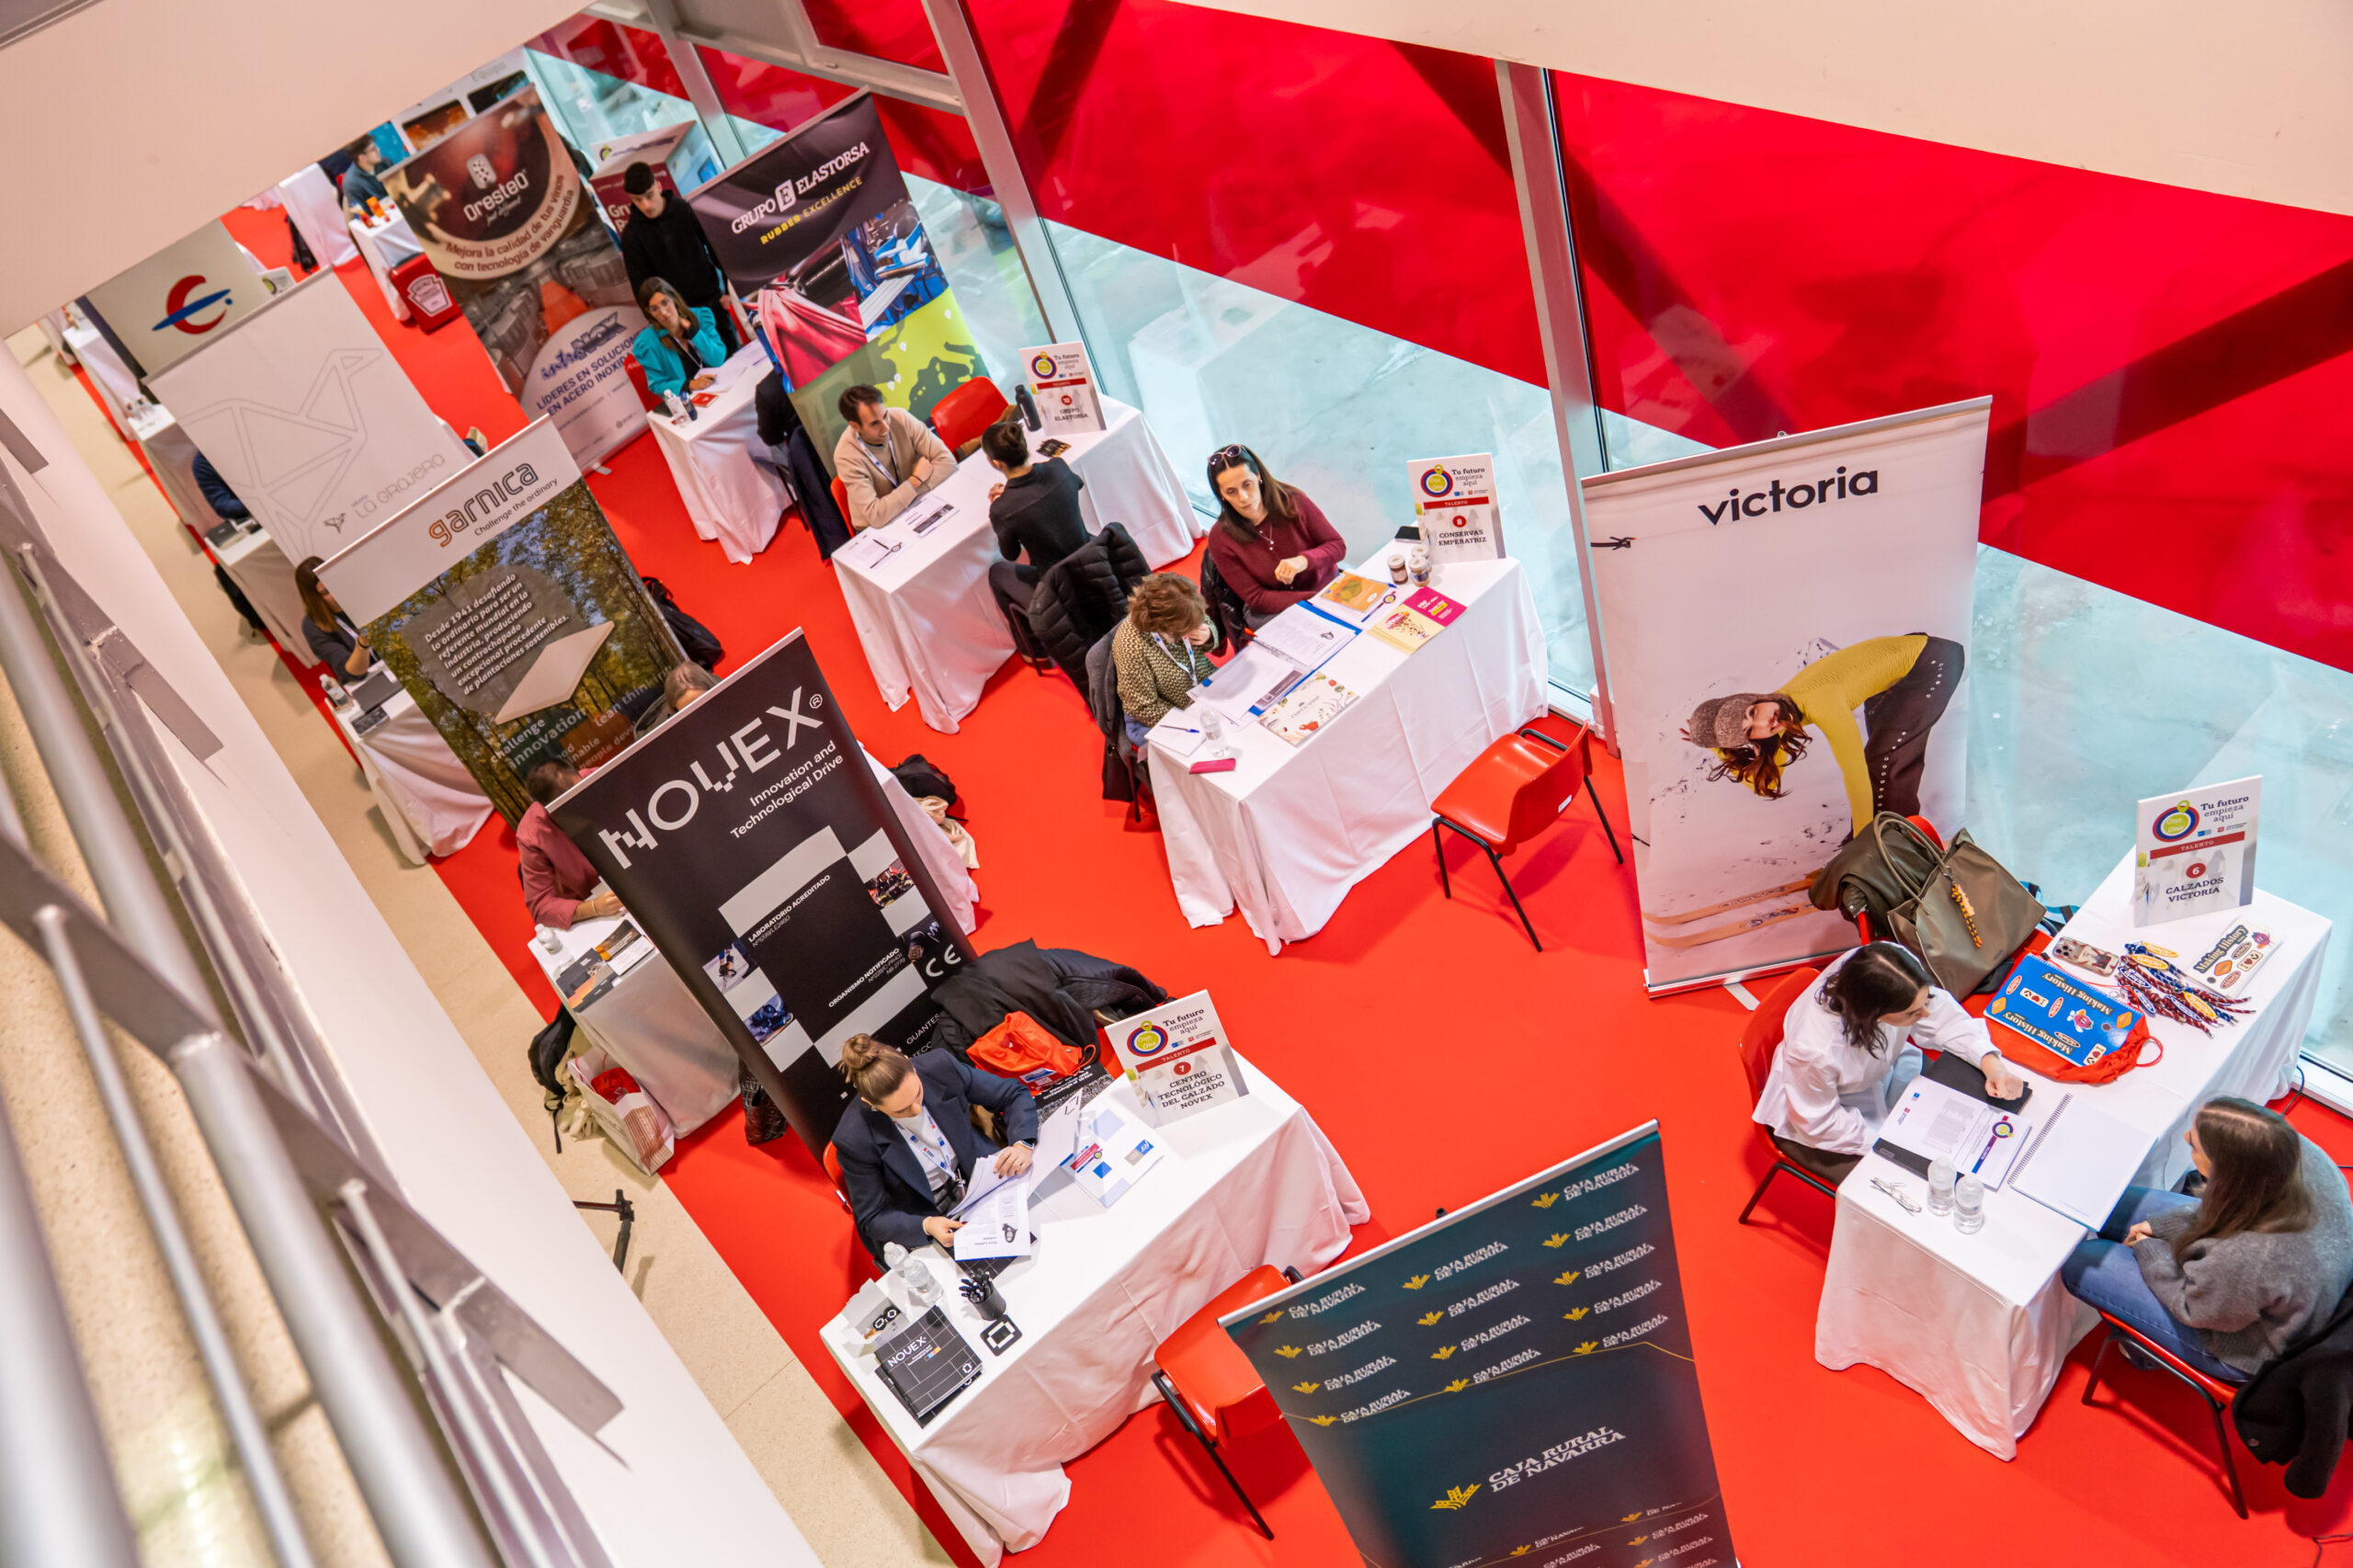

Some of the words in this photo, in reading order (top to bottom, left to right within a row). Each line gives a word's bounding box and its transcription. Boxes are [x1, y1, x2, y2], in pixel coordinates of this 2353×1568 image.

[731, 198, 777, 234] GRUPO
[795, 141, 870, 195] ELASTORSA
[445, 241, 483, 258] Mejora
[485, 247, 495, 257] la
[496, 231, 532, 256] calidad
[530, 221, 543, 234] de
[541, 204, 555, 222] tus
[551, 174, 564, 204] vinos
[759, 214, 801, 245] RUBBER
[801, 176, 863, 218] EXCELLENCE
[454, 260, 475, 271] con
[477, 249, 529, 271] tecnología
[529, 239, 542, 254] de
[540, 188, 574, 243] vanguardia
[536, 377, 576, 411] LÍDERES
[575, 368, 591, 382] EN
[546, 403, 563, 416] EN
[563, 379, 595, 406] ACERO
[428, 462, 540, 549] garnica
[474, 508, 513, 537] Challenge
[512, 498, 528, 513] the
[526, 477, 558, 504] ordinary
[1697, 466, 1878, 526] victoria
[1438, 537, 1487, 546] EMPERATRIZ
[1439, 529, 1483, 539] CONSERVAS
[425, 621, 450, 643] Desde
[450, 606, 473, 625] 1941
[472, 573, 517, 608] desafiando
[431, 641, 441, 653] lo
[441, 614, 480, 645] ordinario
[480, 602, 500, 619] para
[499, 591, 513, 604] ser
[511, 582, 523, 594] un
[438, 631, 475, 661] referente
[475, 606, 509, 634] mundial
[509, 597, 519, 608] en
[518, 590, 529, 602] la
[444, 639, 484, 669] industria,
[483, 601, 533, 642] produciendo
[450, 666, 461, 678] un
[461, 623, 522, 670] contrachapado
[457, 648, 504, 687] excepcional
[505, 616, 547, 654] procedente
[463, 684, 474, 696] de
[475, 648, 526, 689] plantaciones
[525, 615, 570, 650] sostenibles.
[595, 702, 622, 727] lean
[491, 718, 546, 764] challenge
[506, 710, 586, 770] innovation
[749, 760, 813, 807] Innovation
[813, 740, 836, 765] and
[730, 778, 813, 839] Technological
[813, 754, 844, 781] Drive
[2204, 804, 2245, 817] empieza
[2217, 796, 2249, 808] futuro
[2213, 813, 2234, 823] aquí
[2180, 840, 2214, 851] TALENTO
[2165, 877, 2224, 894] CALZADOS
[2168, 887, 2221, 903] VICTORIA
[748, 905, 792, 943] LABORATORIO
[792, 875, 831, 908] ACREDITADO
[2195, 949, 2225, 971] Making
[2218, 928, 2245, 950] History
[829, 976, 864, 1007] ORGANISMO
[864, 948, 899, 978] NOTIFICADO
[2042, 972, 2077, 996] History
[1163, 1018, 1176, 1028] Tu
[1176, 1008, 1204, 1022] futuro
[2078, 991, 2114, 1016] Making
[1169, 1017, 1203, 1031] empieza
[1180, 1024, 1198, 1035] aquí
[2003, 1011, 2037, 1035] History
[1162, 1049, 1191, 1062] TALENTO
[2038, 1029, 2075, 1055] Making
[1158, 1074, 1222, 1100] TECNOLÓGICO
[1162, 1097, 1180, 1108] DEL
[1181, 1081, 1225, 1100] CALZADO
[1169, 1071, 1207, 1088] CENTRO
[1180, 1094, 1213, 1108] NOVEX
[1563, 1178, 1592, 1194] CAJA
[1594, 1163, 1632, 1182] RURAL
[1565, 1189, 1583, 1201] DE
[1585, 1166, 1640, 1193] NAVARRA
[1574, 1221, 1603, 1235] CAJA
[1605, 1204, 1641, 1222] RURAL
[1576, 1230, 1592, 1241] DE
[1595, 1206, 1648, 1233] NAVARRA
[1585, 1259, 1611, 1273] CAJA
[1613, 1243, 1649, 1262] RURAL
[1586, 1268, 1602, 1278] DE
[1604, 1244, 1655, 1271] NAVARRA
[1594, 1296, 1620, 1309] CAJA
[1621, 1279, 1656, 1298] RURAL
[1595, 1303, 1610, 1314] DE
[1613, 1281, 1662, 1306] NAVARRA
[1602, 1331, 1628, 1344] CAJA
[1630, 1313, 1663, 1333] RURAL
[1604, 1338, 1619, 1348] DE
[1621, 1315, 1668, 1342] NAVARRA
[1488, 1457, 1540, 1483] CAJA
[1542, 1426, 1614, 1460] RURAL
[1491, 1473, 1520, 1493] DE
[1527, 1431, 1626, 1478] NAVARRA
